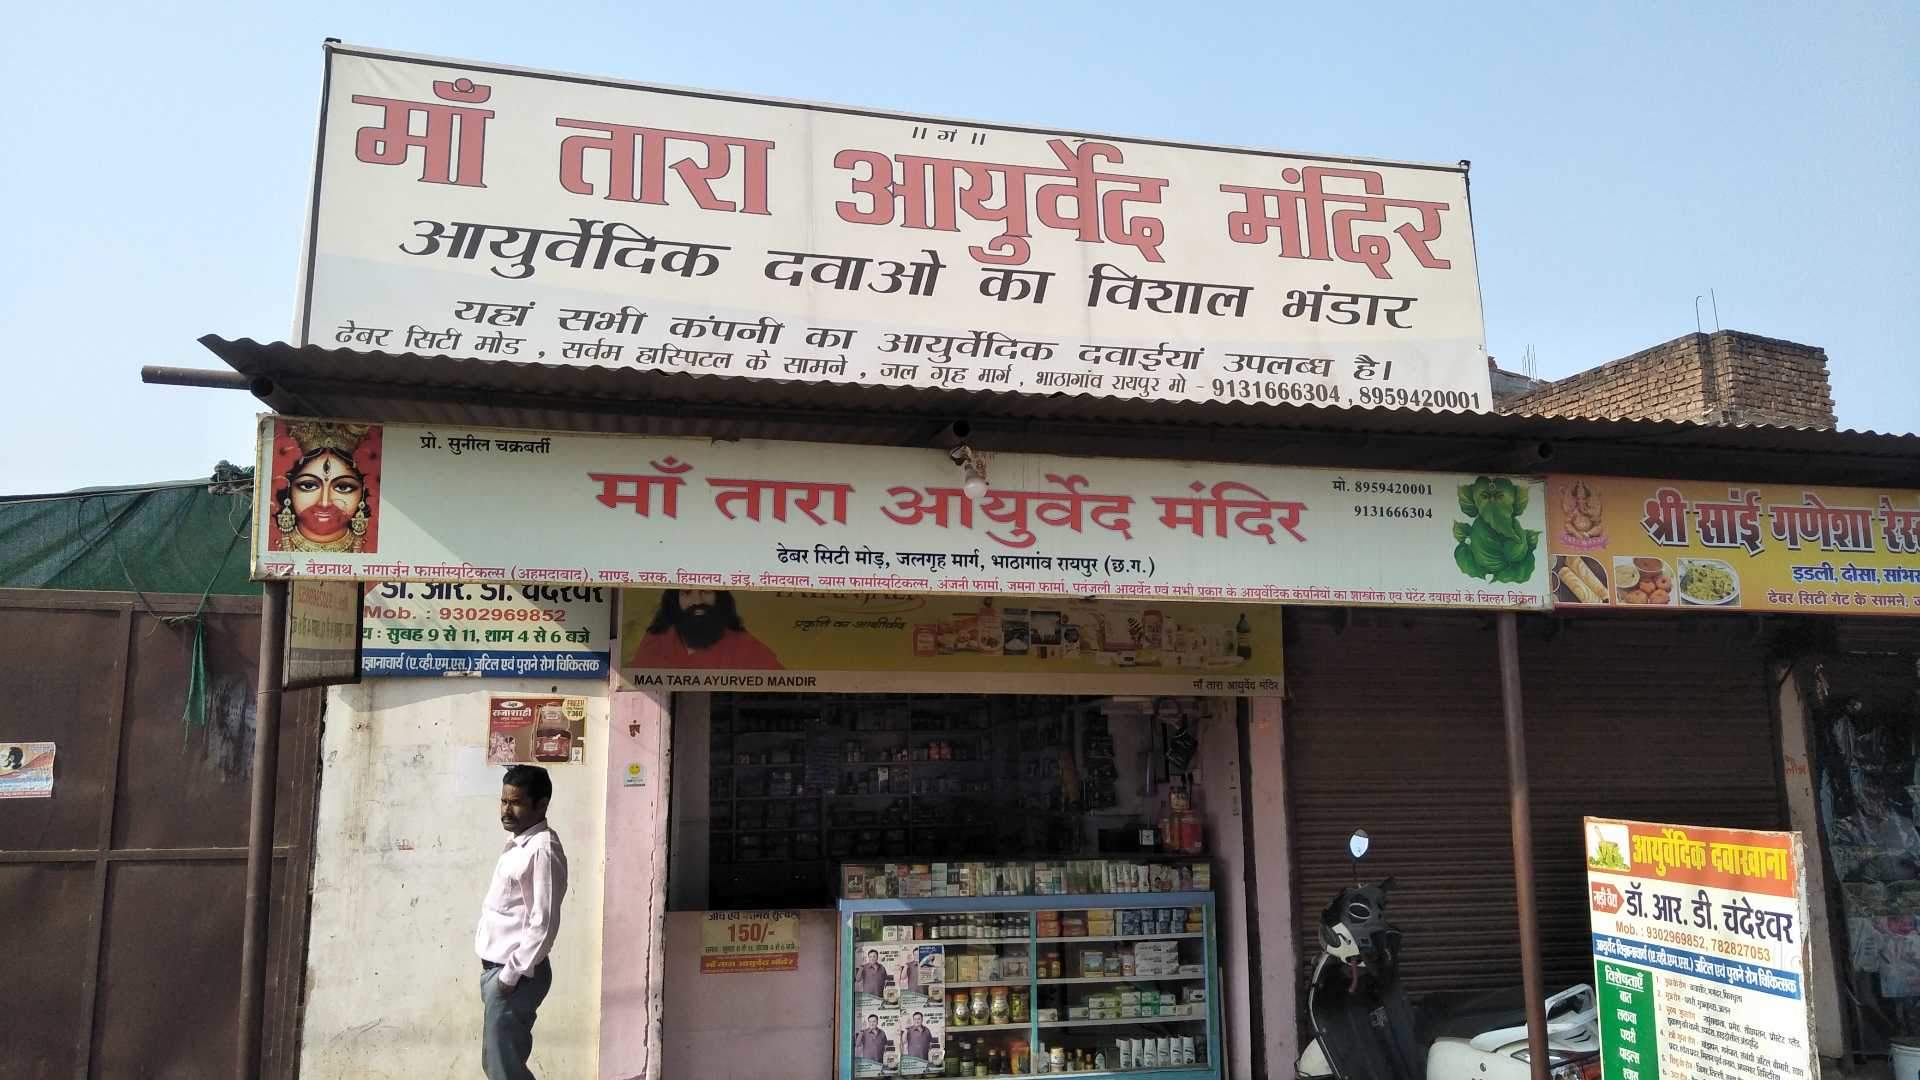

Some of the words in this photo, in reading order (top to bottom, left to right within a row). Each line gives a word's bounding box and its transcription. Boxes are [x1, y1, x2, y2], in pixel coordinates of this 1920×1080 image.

[351, 78, 495, 189] माँ
[555, 117, 775, 216] तारा
[833, 138, 1169, 265] आयुर्वेद
[1219, 165, 1451, 279] मंदिर
[399, 217, 731, 280] आयुर्वेदिक
[764, 249, 947, 297] दवाओ
[979, 267, 1056, 304] का
[1087, 264, 1254, 318] विशाल
[1281, 283, 1418, 329] भंडार
[454, 299, 536, 326] यहां
[557, 305, 648, 335] सभी
[669, 314, 786, 345] कंपनी
[805, 327, 858, 350] का
[877, 329, 1059, 364] आयुर्वेदिक
[1078, 341, 1205, 373] दवाईयां
[1223, 353, 1335, 378] उपलब्ध
[334, 320, 393, 348] ढेबर
[404, 325, 463, 352] सिटी
[562, 337, 625, 363] सर्वम
[746, 349, 772, 373] के
[783, 355, 848, 377] सामने
[880, 362, 918, 380] जल
[930, 365, 968, 387] गृह
[978, 364, 1013, 385] मार्ग
[1035, 369, 1104, 390] भाठागांव
[1111, 374, 1160, 398] रायपुर
[1168, 373, 1186, 394] मो
[1212, 379, 1341, 404] 9131666304
[1359, 386, 1481, 410] 8959420001
[449, 435, 490, 456] सुनील
[496, 436, 551, 454] चक्रबर्ती
[1332, 479, 1350, 494] मो.
[1354, 481, 1433, 496] 8959420001
[588, 456, 693, 520] माँ
[705, 476, 855, 526] तारा
[879, 473, 1137, 549] आयुर्वेद
[1151, 480, 1310, 545] मंदिर
[1353, 504, 1434, 520] 9131666304
[1641, 488, 1688, 547] श्री
[1769, 492, 1876, 553] गणेशा
[776, 542, 809, 565] ढेबर
[814, 544, 849, 567] सिटी
[854, 545, 890, 571] मोड़,
[896, 551, 946, 577] जलगृह
[951, 548, 986, 573] मार्ग,
[991, 550, 1052, 571] भाठागांव
[1057, 556, 1099, 577] रायपुर
[1104, 554, 1156, 577] (छ.ग.)
[1791, 563, 1838, 584] इडली,
[1840, 563, 1880, 585] दोसा,
[1333, 589, 1347, 601] का
[1767, 590, 1793, 605] ढेबर
[1798, 590, 1826, 606] सिटी
[1831, 591, 1849, 607] गेट
[1854, 592, 1866, 607] के
[363, 606, 416, 621] Mob.
[439, 607, 566, 622] 9302969852
[386, 627, 424, 644] सुबह
[428, 628, 439, 641] 9
[443, 625, 457, 642] से
[484, 628, 513, 643] शाम
[518, 629, 530, 642] 4
[533, 626, 547, 643] से
[550, 629, 561, 643] 6
[565, 626, 591, 643] बजे
[474, 653, 500, 672] जटिल
[501, 655, 515, 671] एवं
[517, 655, 538, 674] पुराने
[540, 656, 555, 672] रोग
[556, 655, 600, 673] चिकित्सक
[634, 675, 663, 686] MAA
[666, 675, 703, 686] TARA
[703, 675, 764, 687] AYURVED
[766, 676, 816, 687] MANDIR
[1631, 827, 1706, 876] आयुर्वेदिक
[1710, 842, 1787, 880] दवाखाना
[1625, 881, 1648, 918] डॉ.
[1652, 893, 1688, 925] आर.
[1691, 889, 1718, 931] डी.
[1721, 896, 1794, 944] चंदेश्वर
[728, 923, 775, 943] 150/-
[1616, 920, 1639, 936] Mob.
[1711, 938, 1771, 962] 782827053
